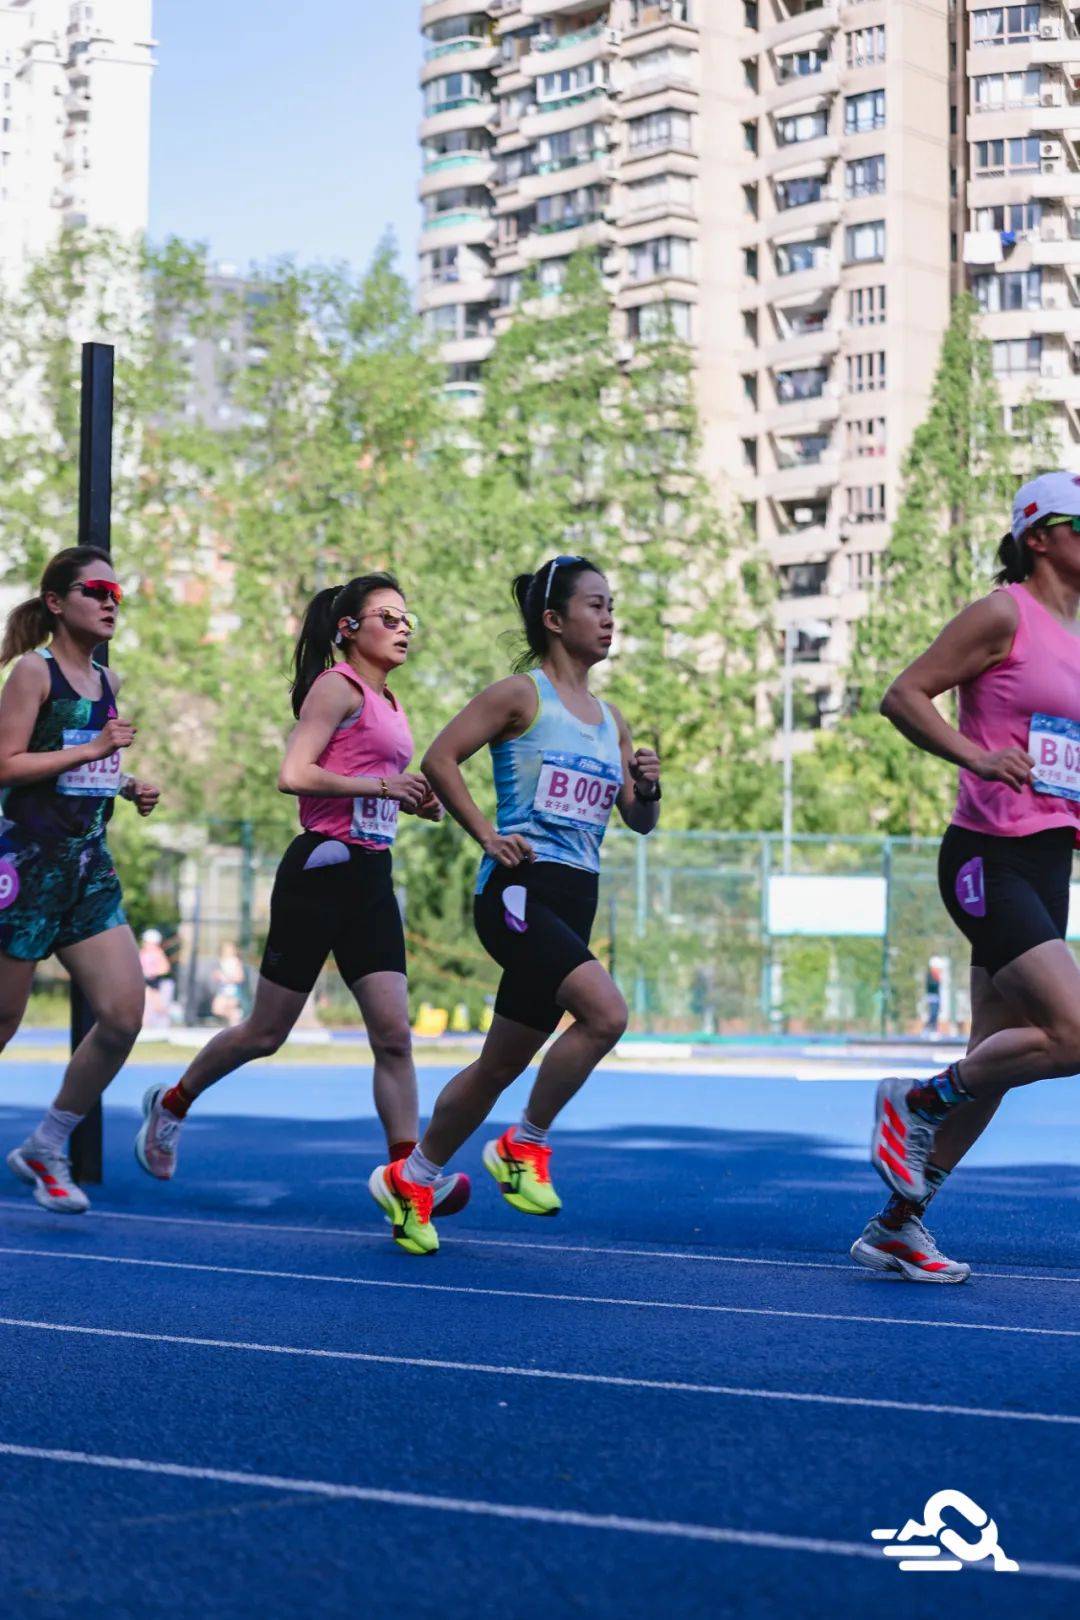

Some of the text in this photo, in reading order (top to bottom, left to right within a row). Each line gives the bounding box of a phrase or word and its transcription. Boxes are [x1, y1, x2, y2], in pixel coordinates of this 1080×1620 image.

[1041, 738, 1058, 766] B
[547, 771, 617, 810] B 005
[362, 797, 377, 818] B
